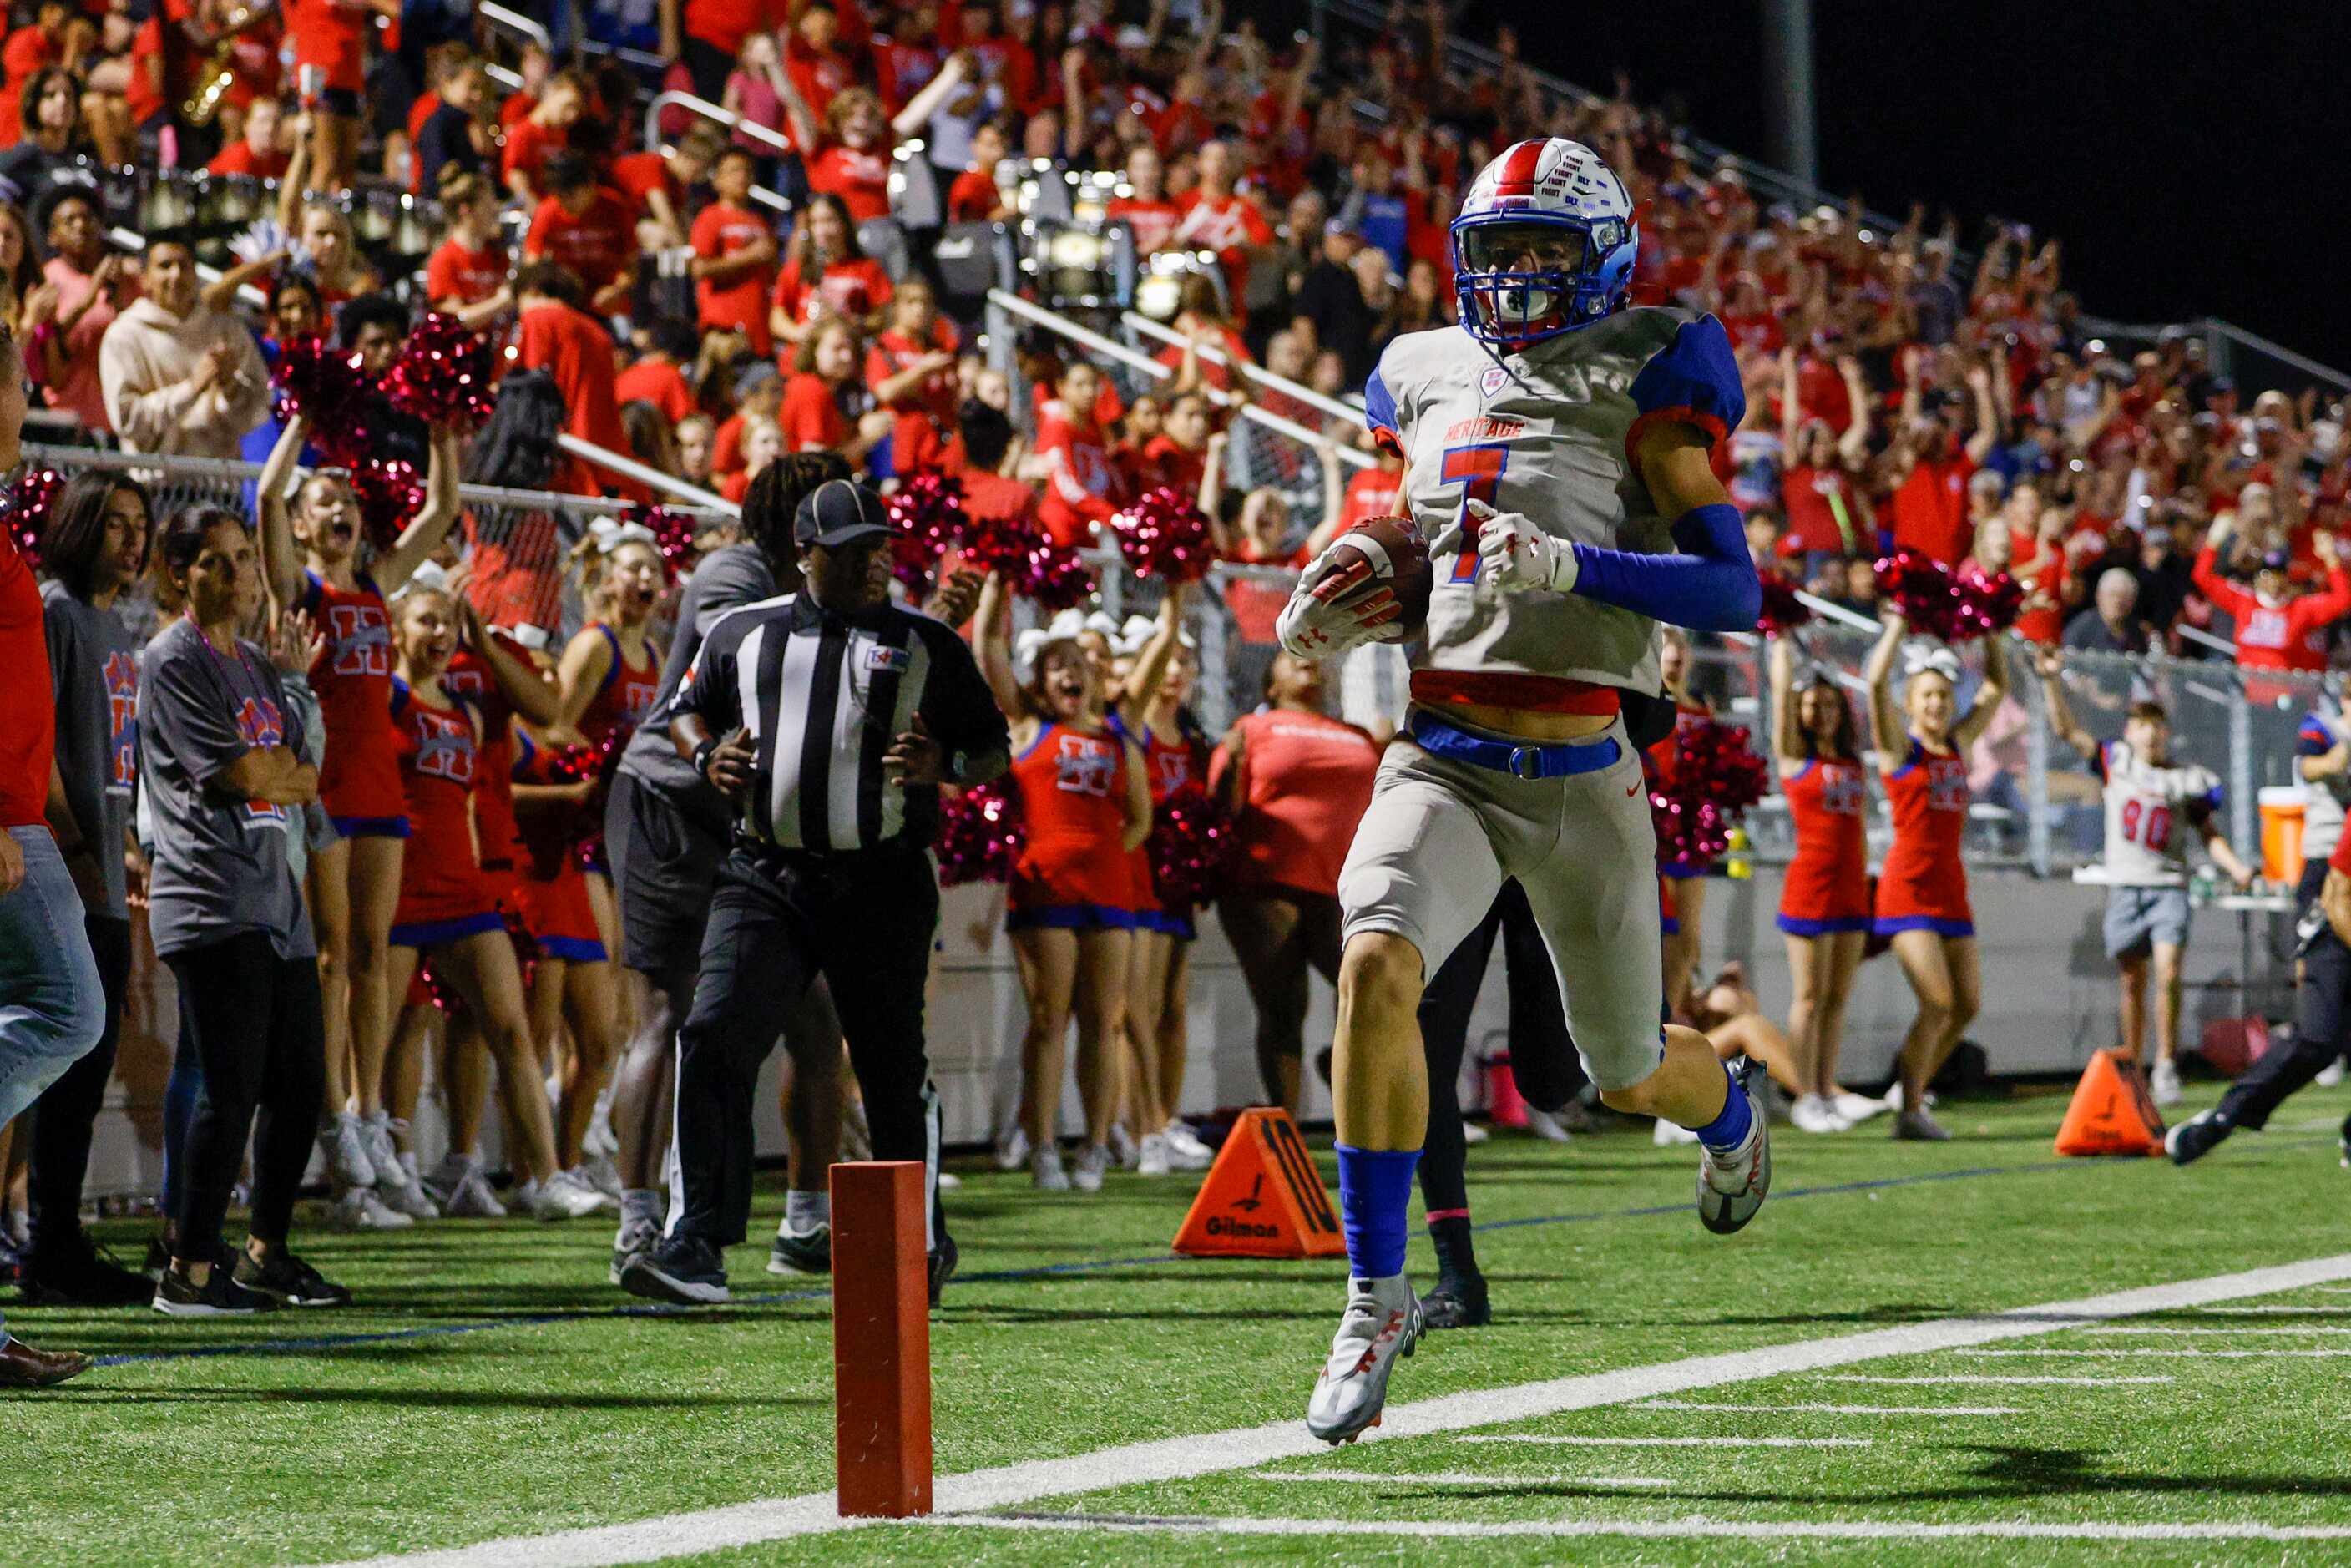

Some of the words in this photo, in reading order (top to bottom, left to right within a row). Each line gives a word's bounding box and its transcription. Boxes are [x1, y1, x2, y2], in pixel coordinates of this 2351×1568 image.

[1548, 177, 1566, 187] FIGHT
[1555, 169, 1573, 179] FIGHT
[1541, 187, 1560, 197] FIGHT
[1443, 417, 1525, 441] HERITAGE
[1440, 443, 1510, 584] 7
[1206, 1216, 1279, 1238] Gilman
